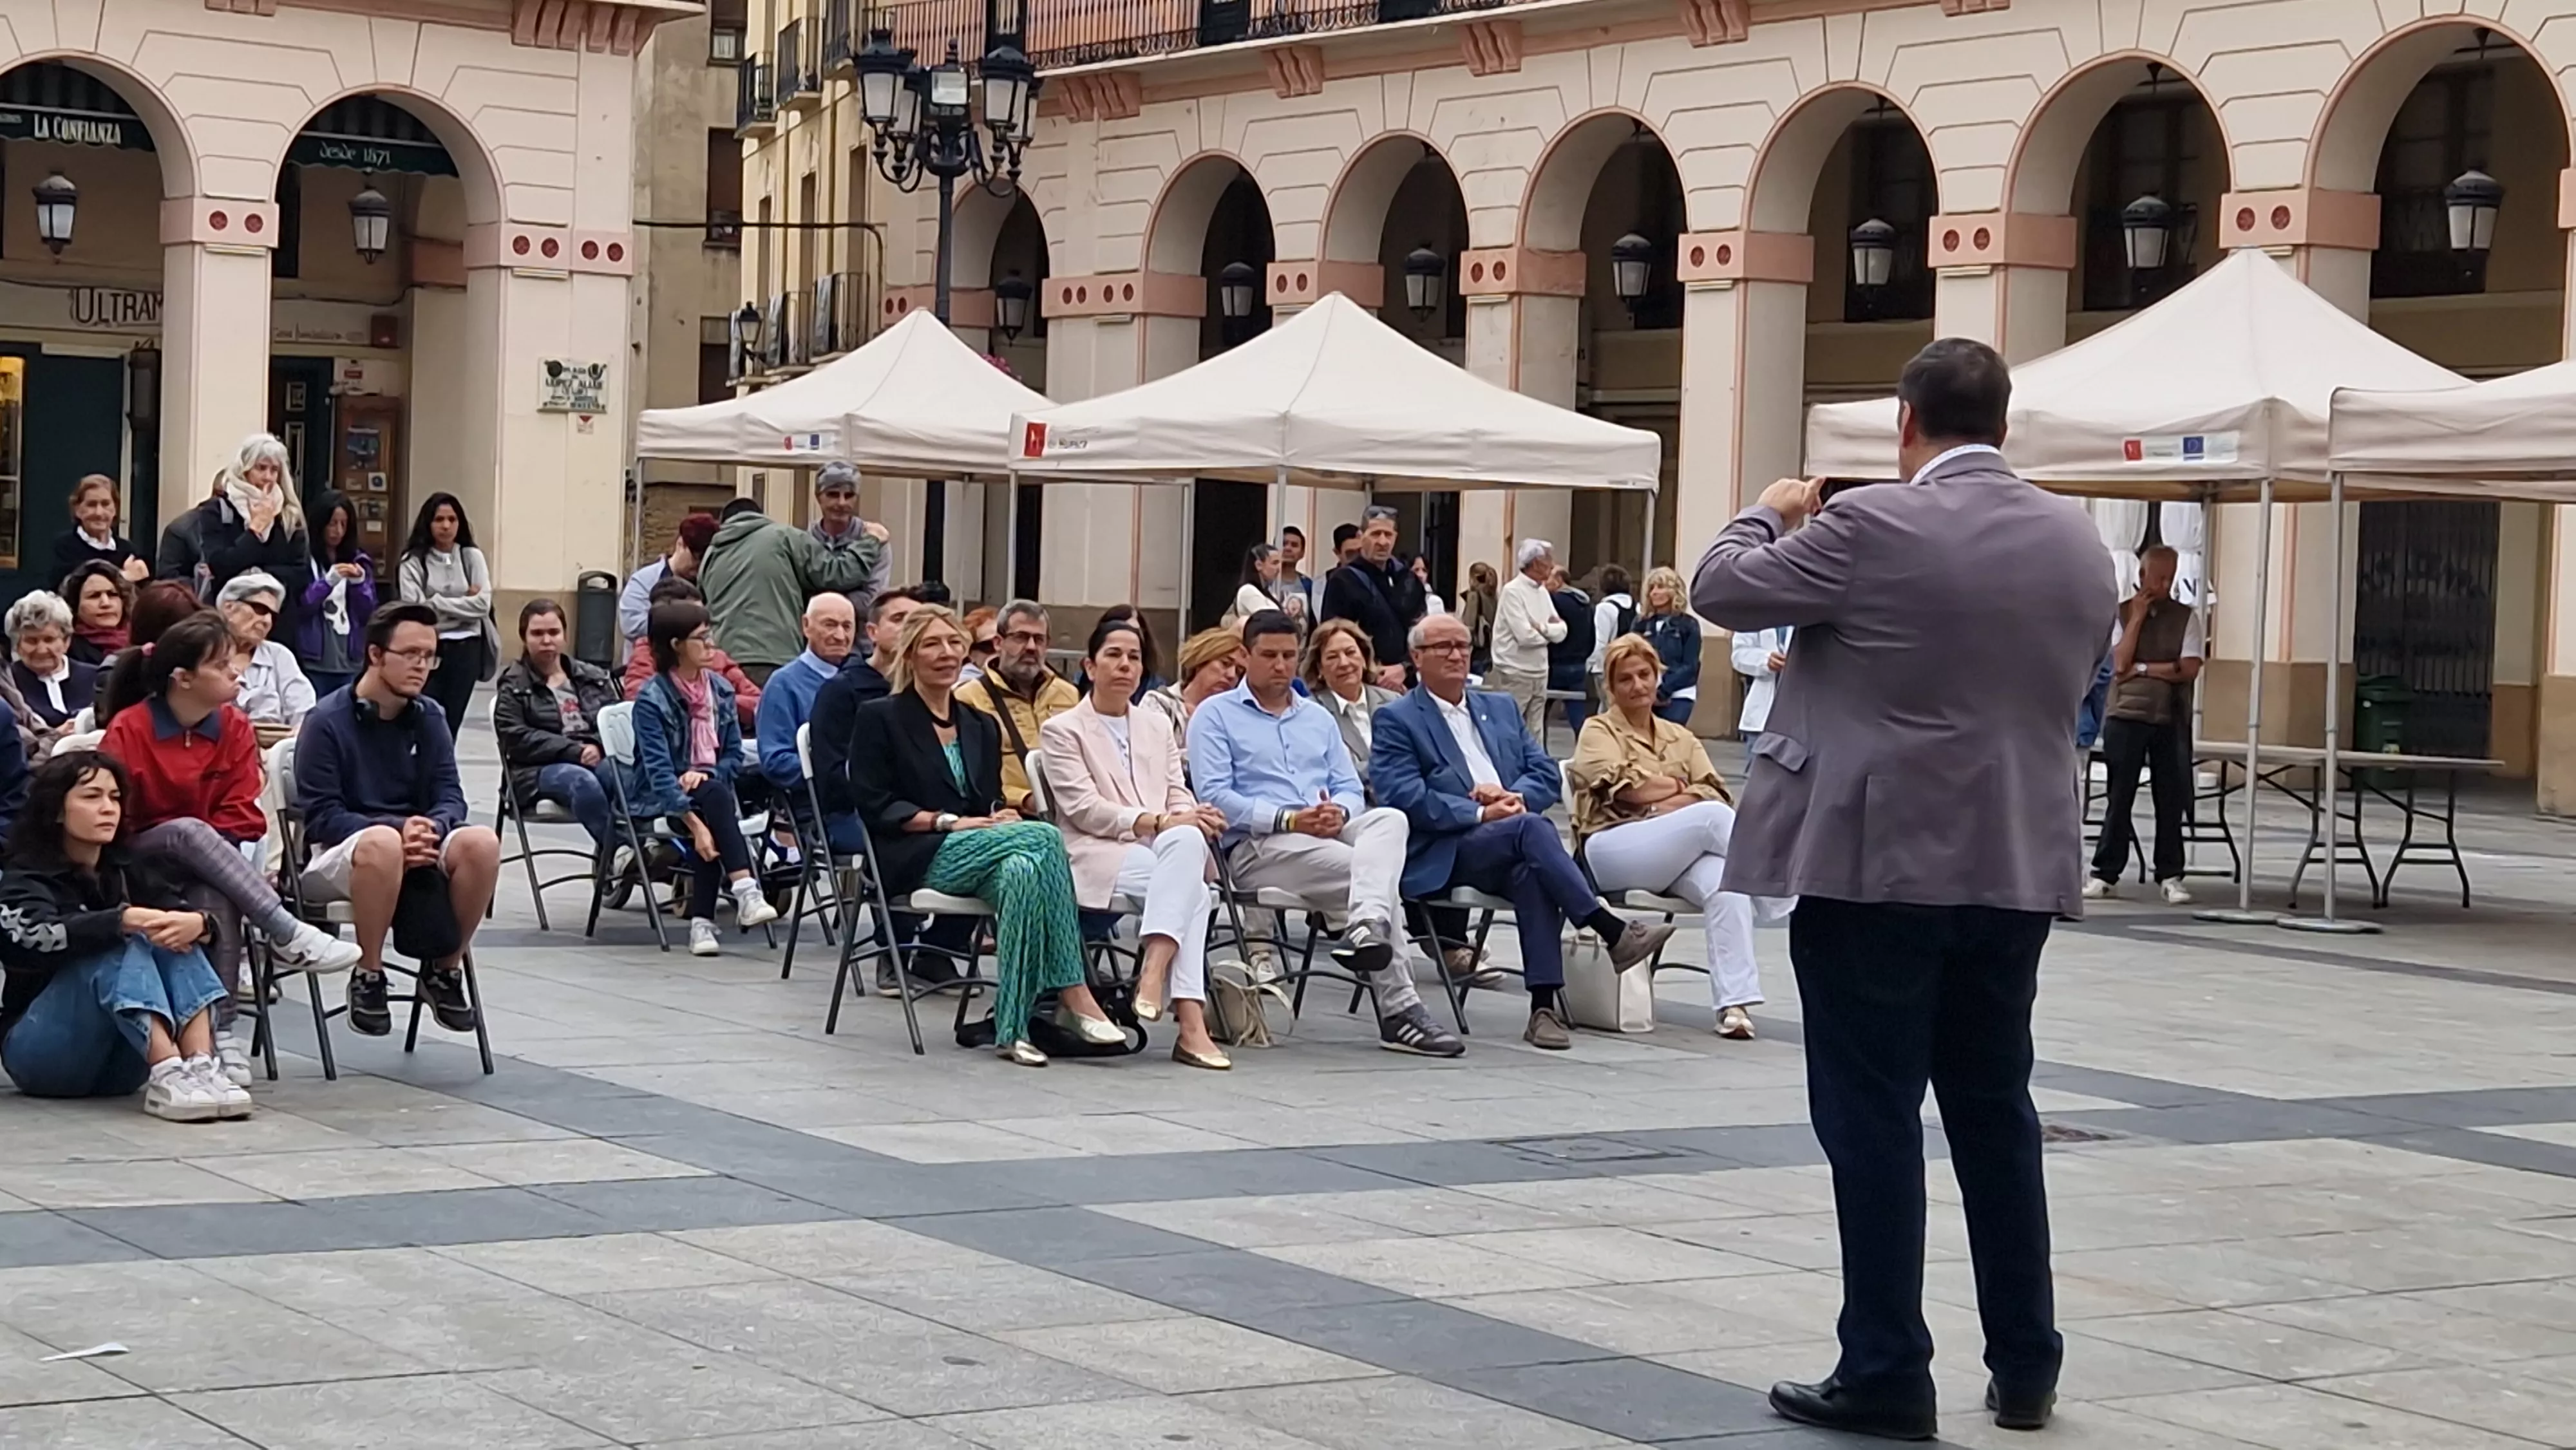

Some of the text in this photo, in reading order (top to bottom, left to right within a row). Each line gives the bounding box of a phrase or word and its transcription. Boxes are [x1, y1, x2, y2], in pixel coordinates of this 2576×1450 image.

[34, 113, 50, 138] LA
[53, 116, 121, 144] CONFIANZA
[319, 141, 357, 160] desde
